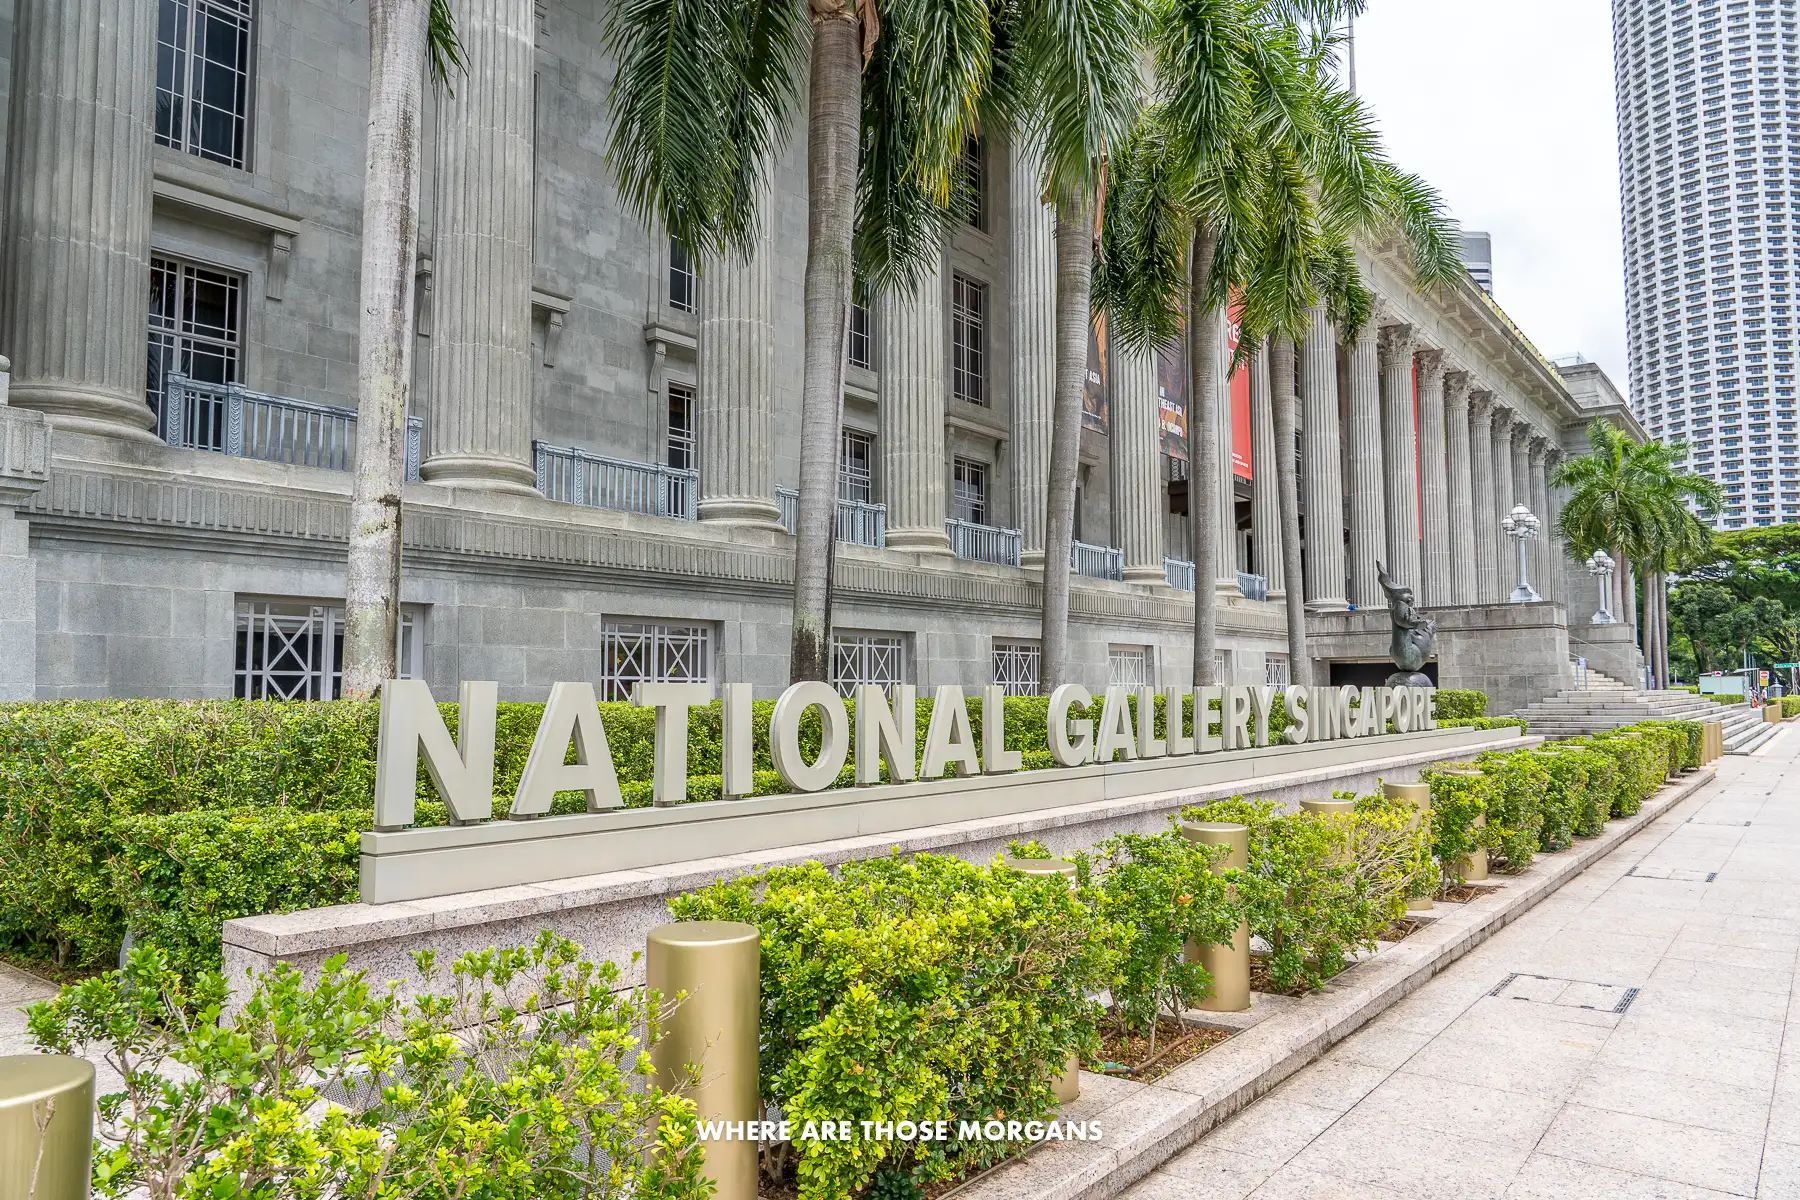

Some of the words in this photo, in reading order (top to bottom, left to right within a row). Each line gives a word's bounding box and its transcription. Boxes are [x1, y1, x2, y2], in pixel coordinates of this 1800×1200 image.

[1158, 397, 1175, 413] THEAST
[374, 679, 1022, 827] NATIONAL
[1047, 683, 1276, 767] GALLERY
[1284, 685, 1438, 744] SINGAPORE
